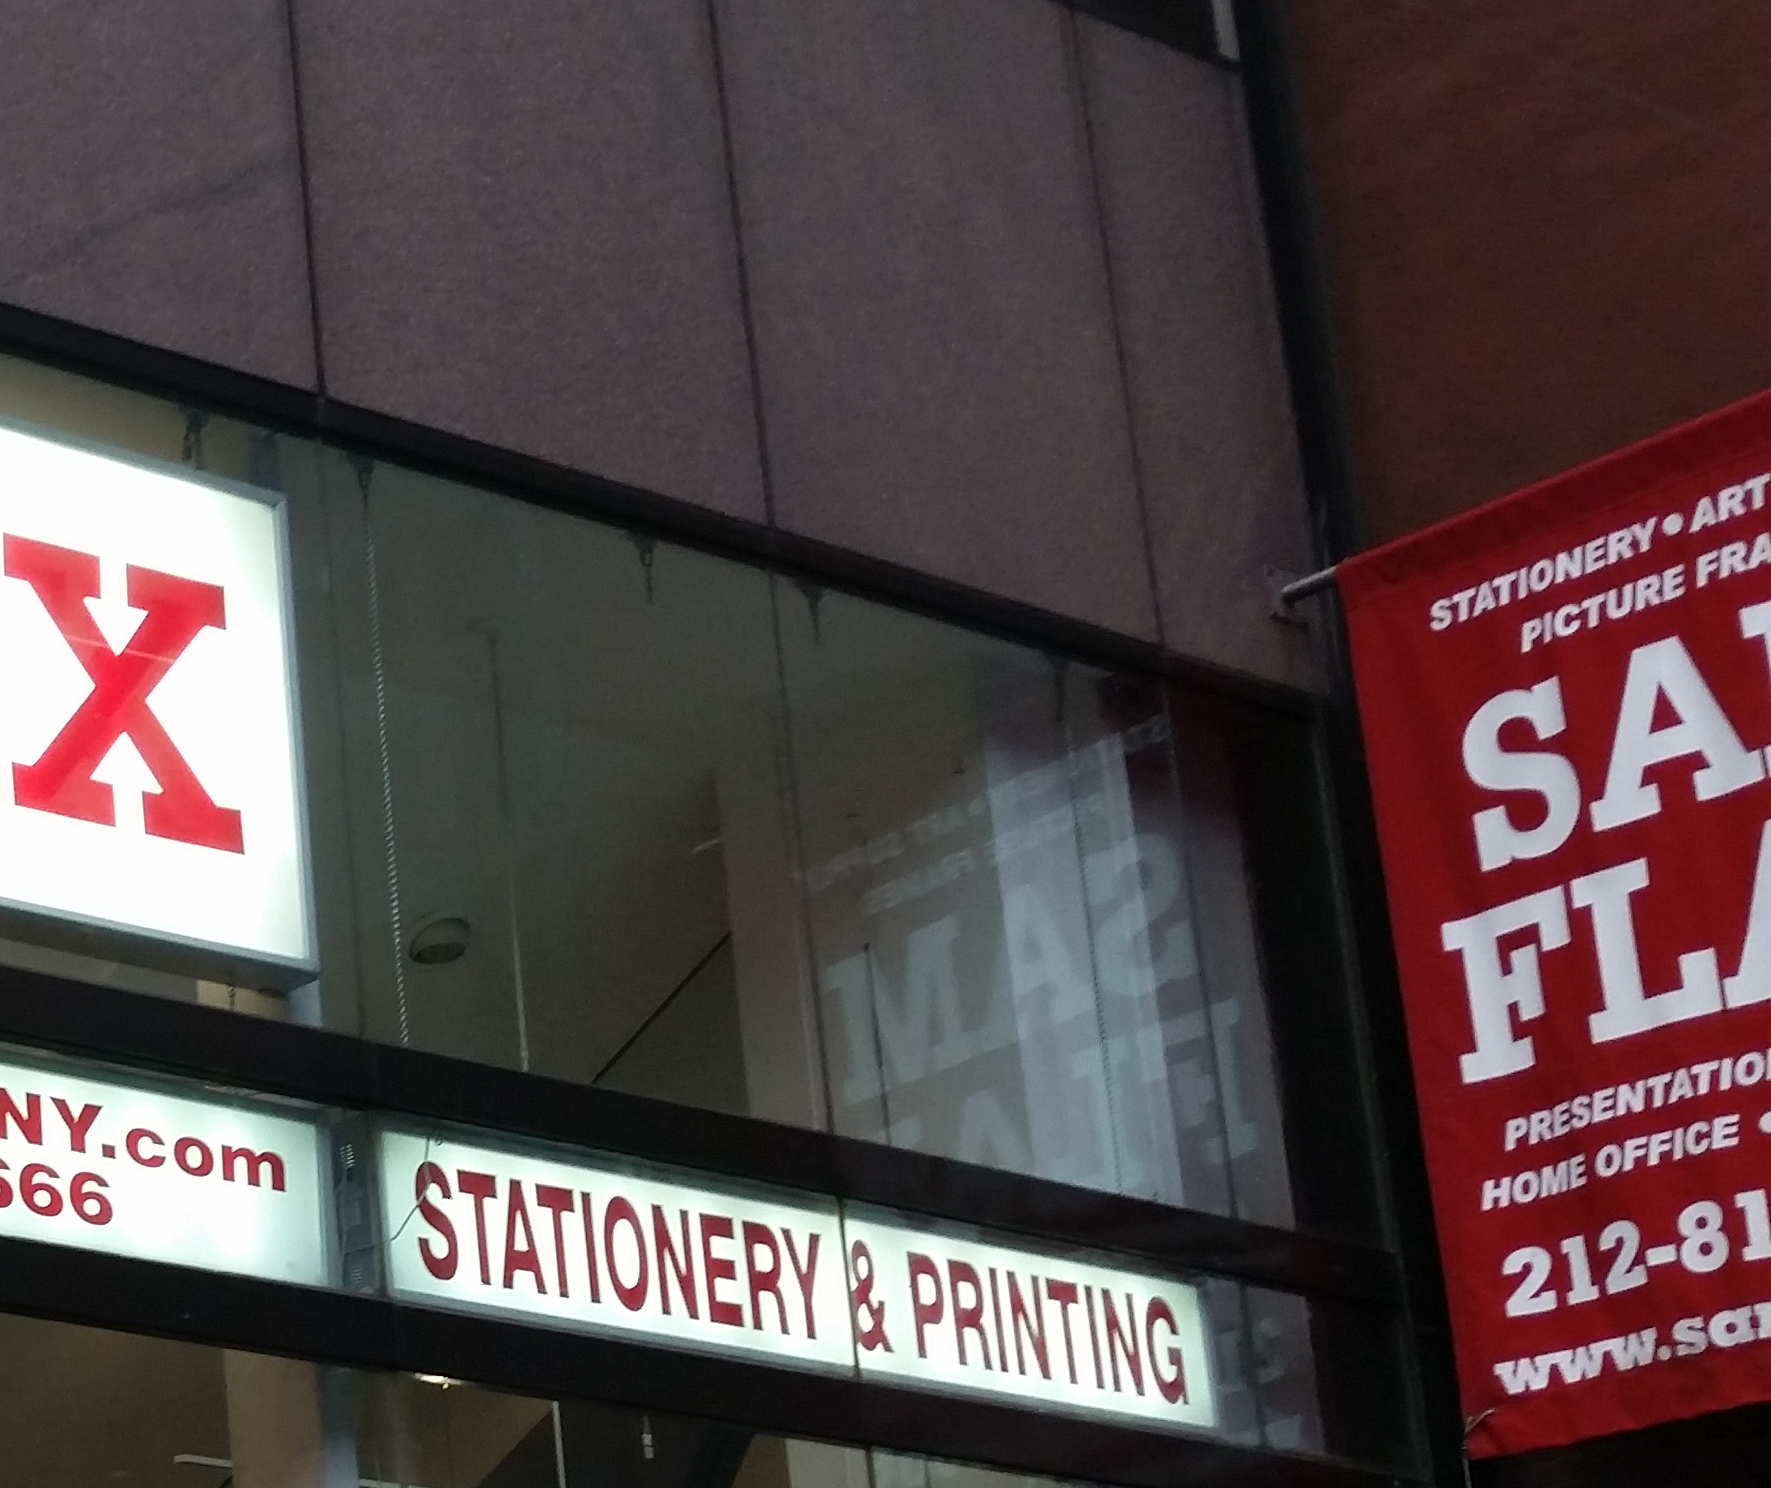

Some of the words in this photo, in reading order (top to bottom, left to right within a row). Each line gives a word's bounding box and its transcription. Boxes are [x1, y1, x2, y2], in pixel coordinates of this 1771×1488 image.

[1429, 516, 1659, 631] STATIONERY
[1520, 563, 1687, 654] PICTURE
[1461, 600, 1771, 874] SA
[1504, 1048, 1771, 1152] PRESENTATIO
[1481, 1154, 1587, 1212] HOME
[1595, 1114, 1741, 1179] OFFICE
[415, 1160, 821, 1341] STATIONERY
[848, 1236, 895, 1354] &
[909, 1252, 1191, 1407] PRINTING
